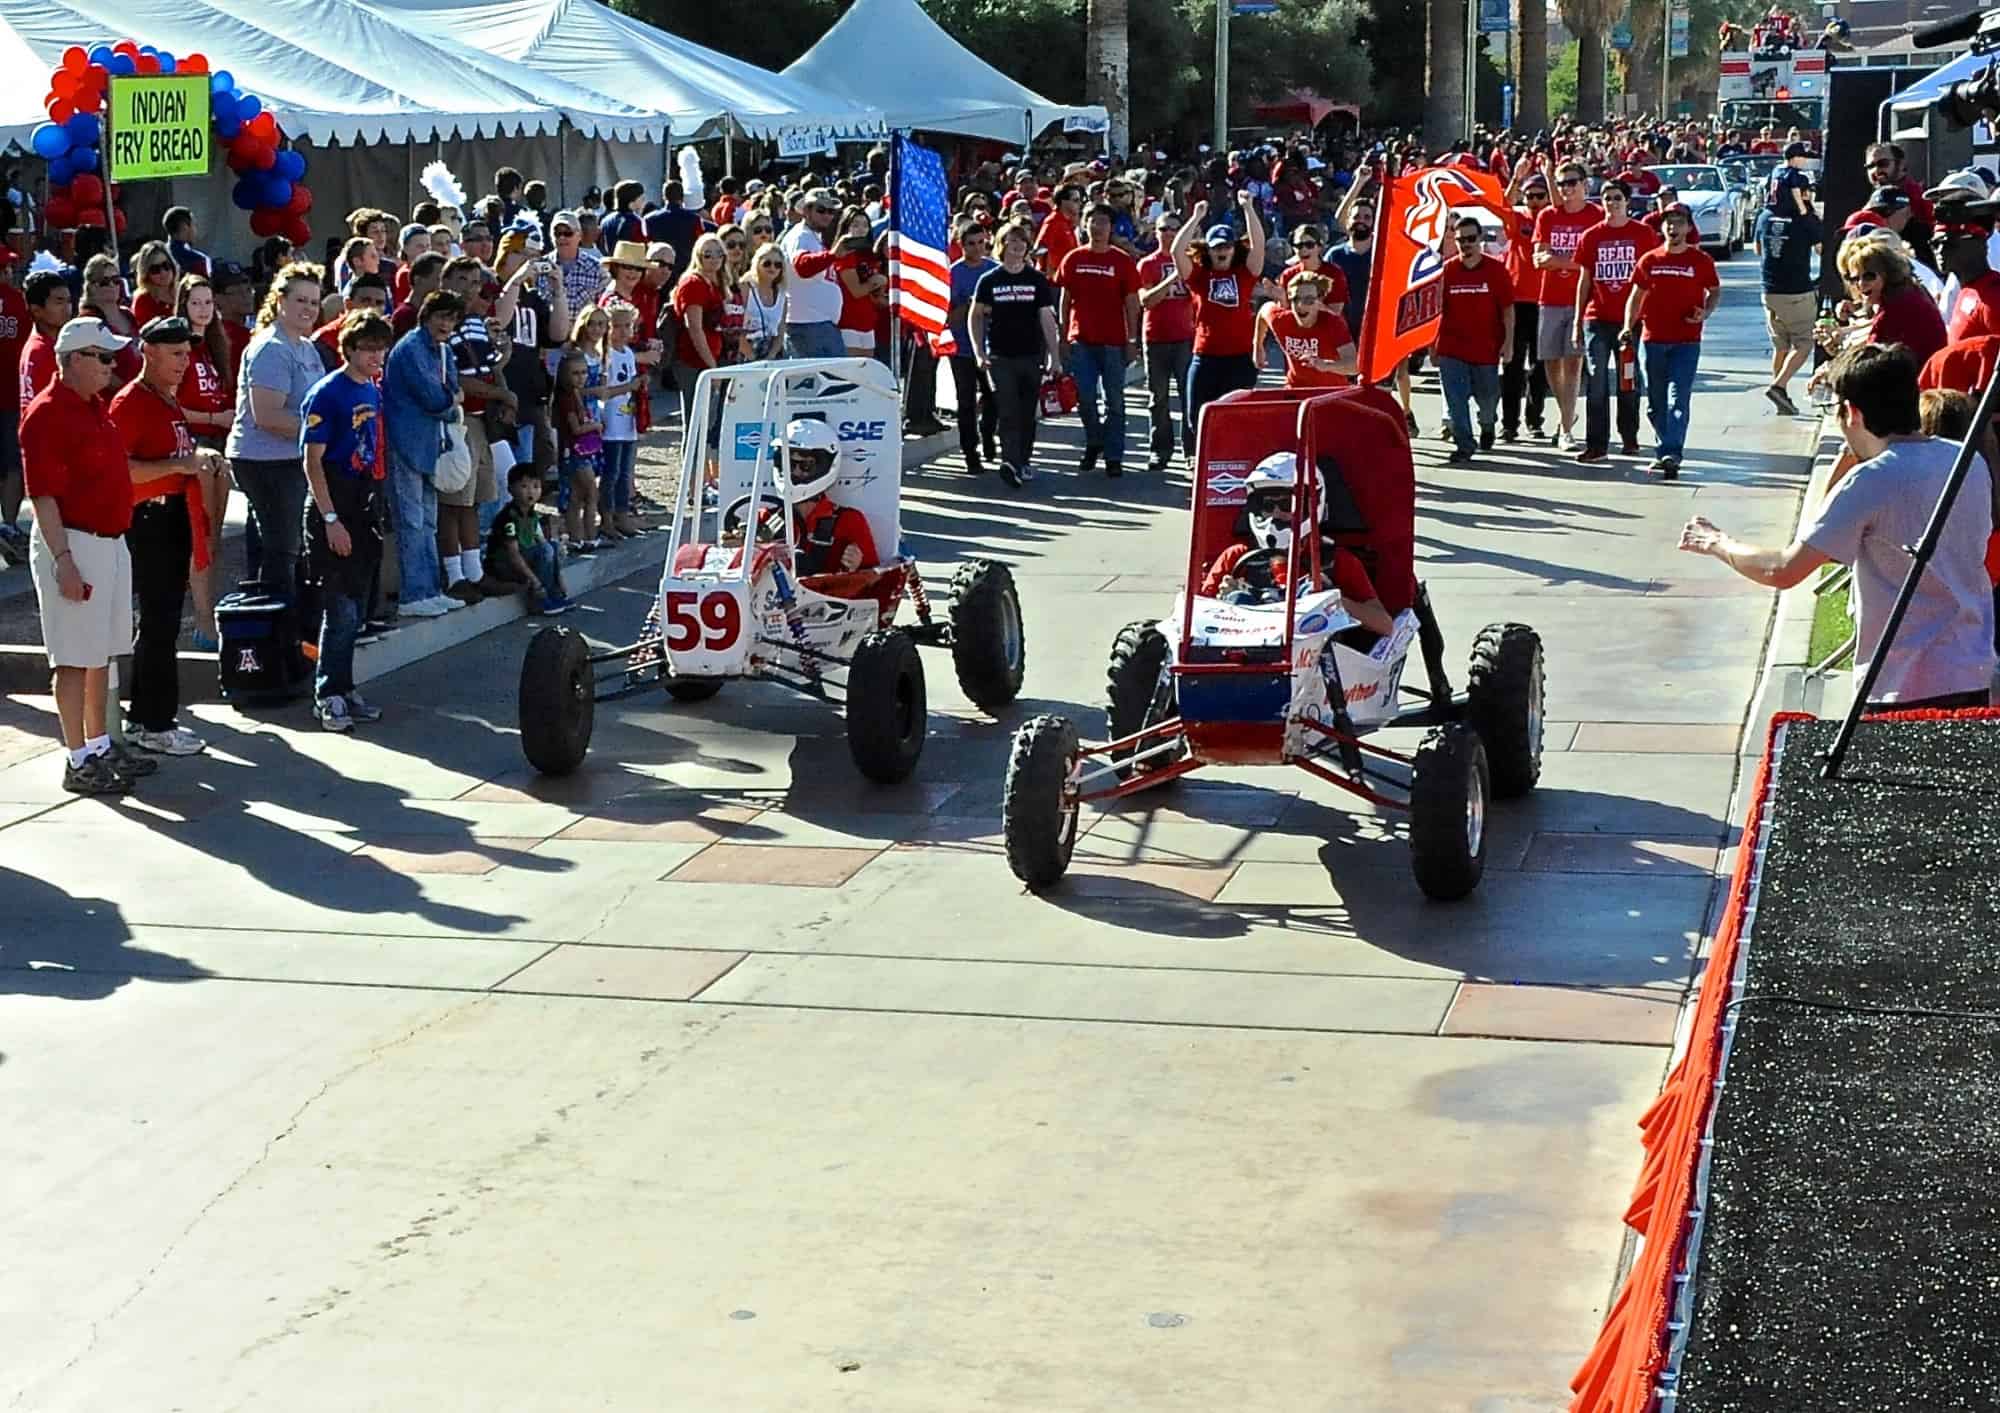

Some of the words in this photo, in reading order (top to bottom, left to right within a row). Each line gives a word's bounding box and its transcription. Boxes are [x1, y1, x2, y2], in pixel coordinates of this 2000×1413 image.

[132, 90, 186, 125] INDIAN
[115, 130, 145, 165] FRY
[150, 127, 203, 162] BREAD
[838, 421, 886, 441] SAE
[504, 522, 516, 537] 3
[665, 591, 741, 652] 59
[239, 649, 260, 673] A
